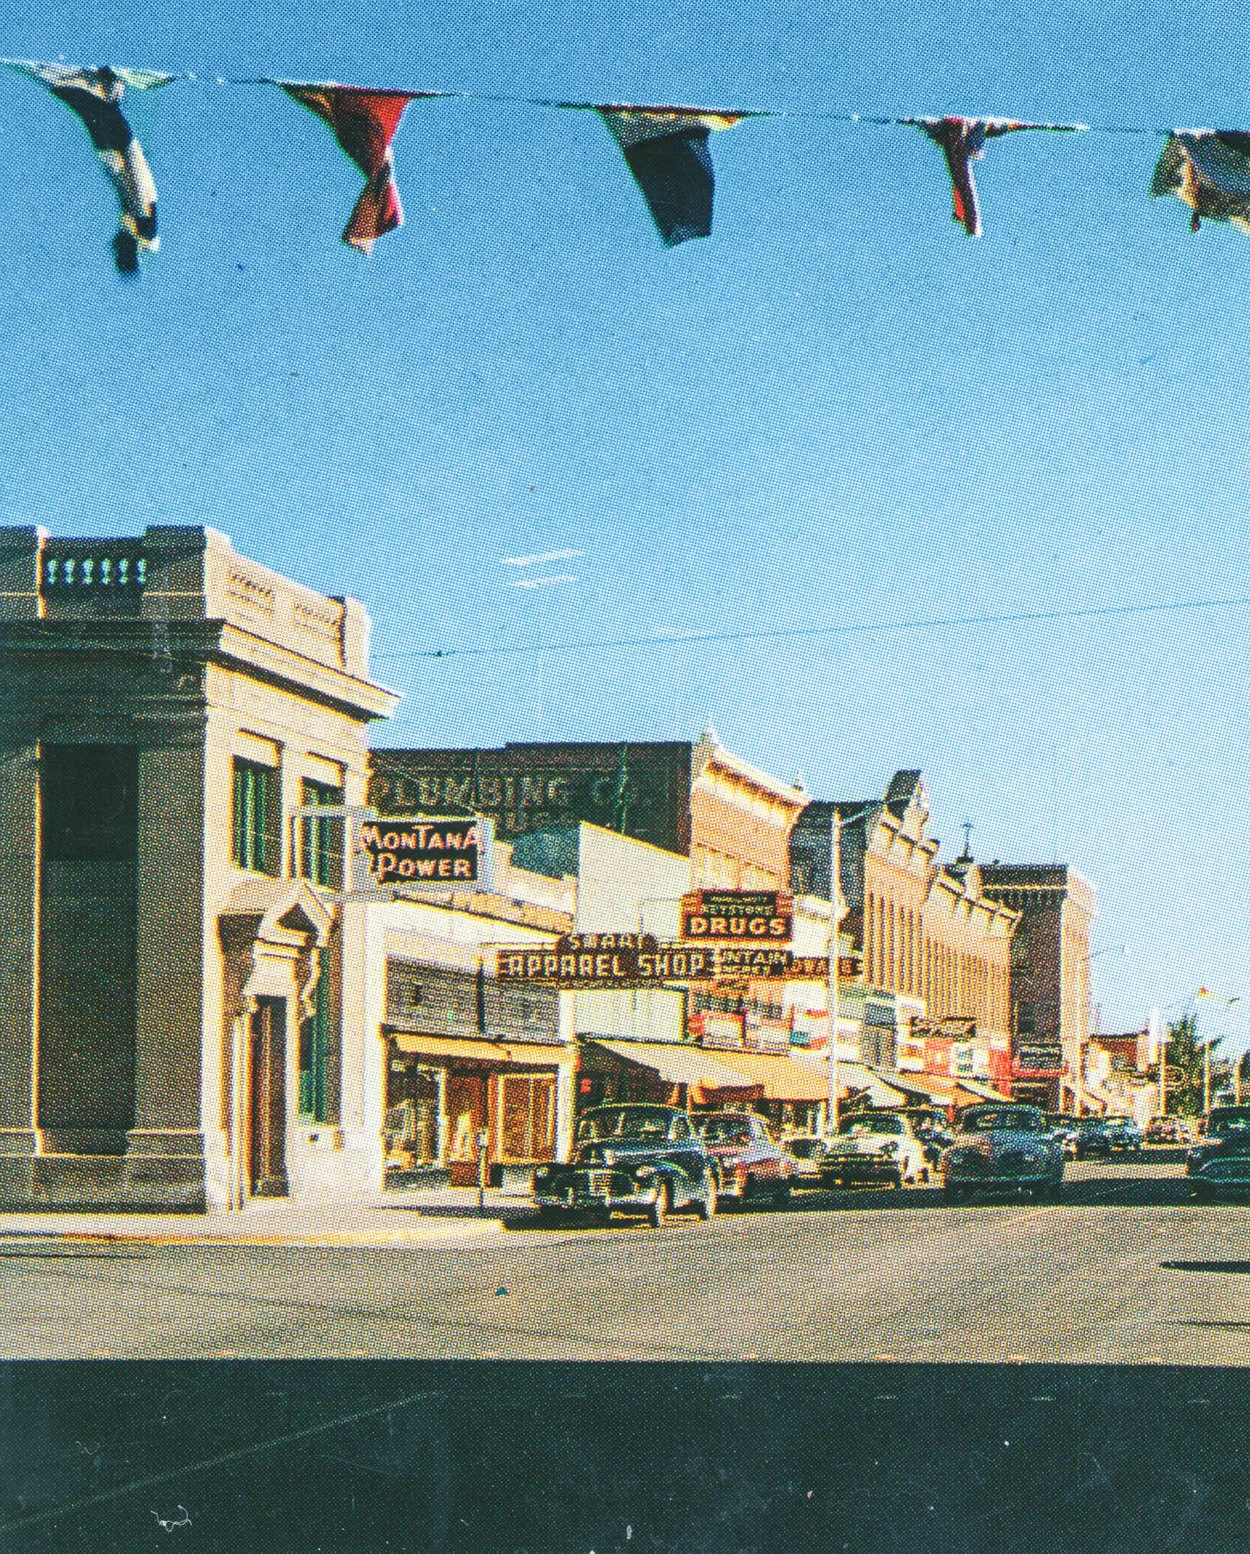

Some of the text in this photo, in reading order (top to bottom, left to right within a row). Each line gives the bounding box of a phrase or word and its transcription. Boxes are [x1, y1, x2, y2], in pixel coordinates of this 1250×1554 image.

[369, 776, 571, 807] PLUMBING
[361, 825, 479, 851] MONTANA
[376, 852, 472, 881] POWER
[690, 917, 786, 935] DRUGS
[567, 934, 645, 949] SMART
[508, 953, 705, 977] APPAREL SHOP
